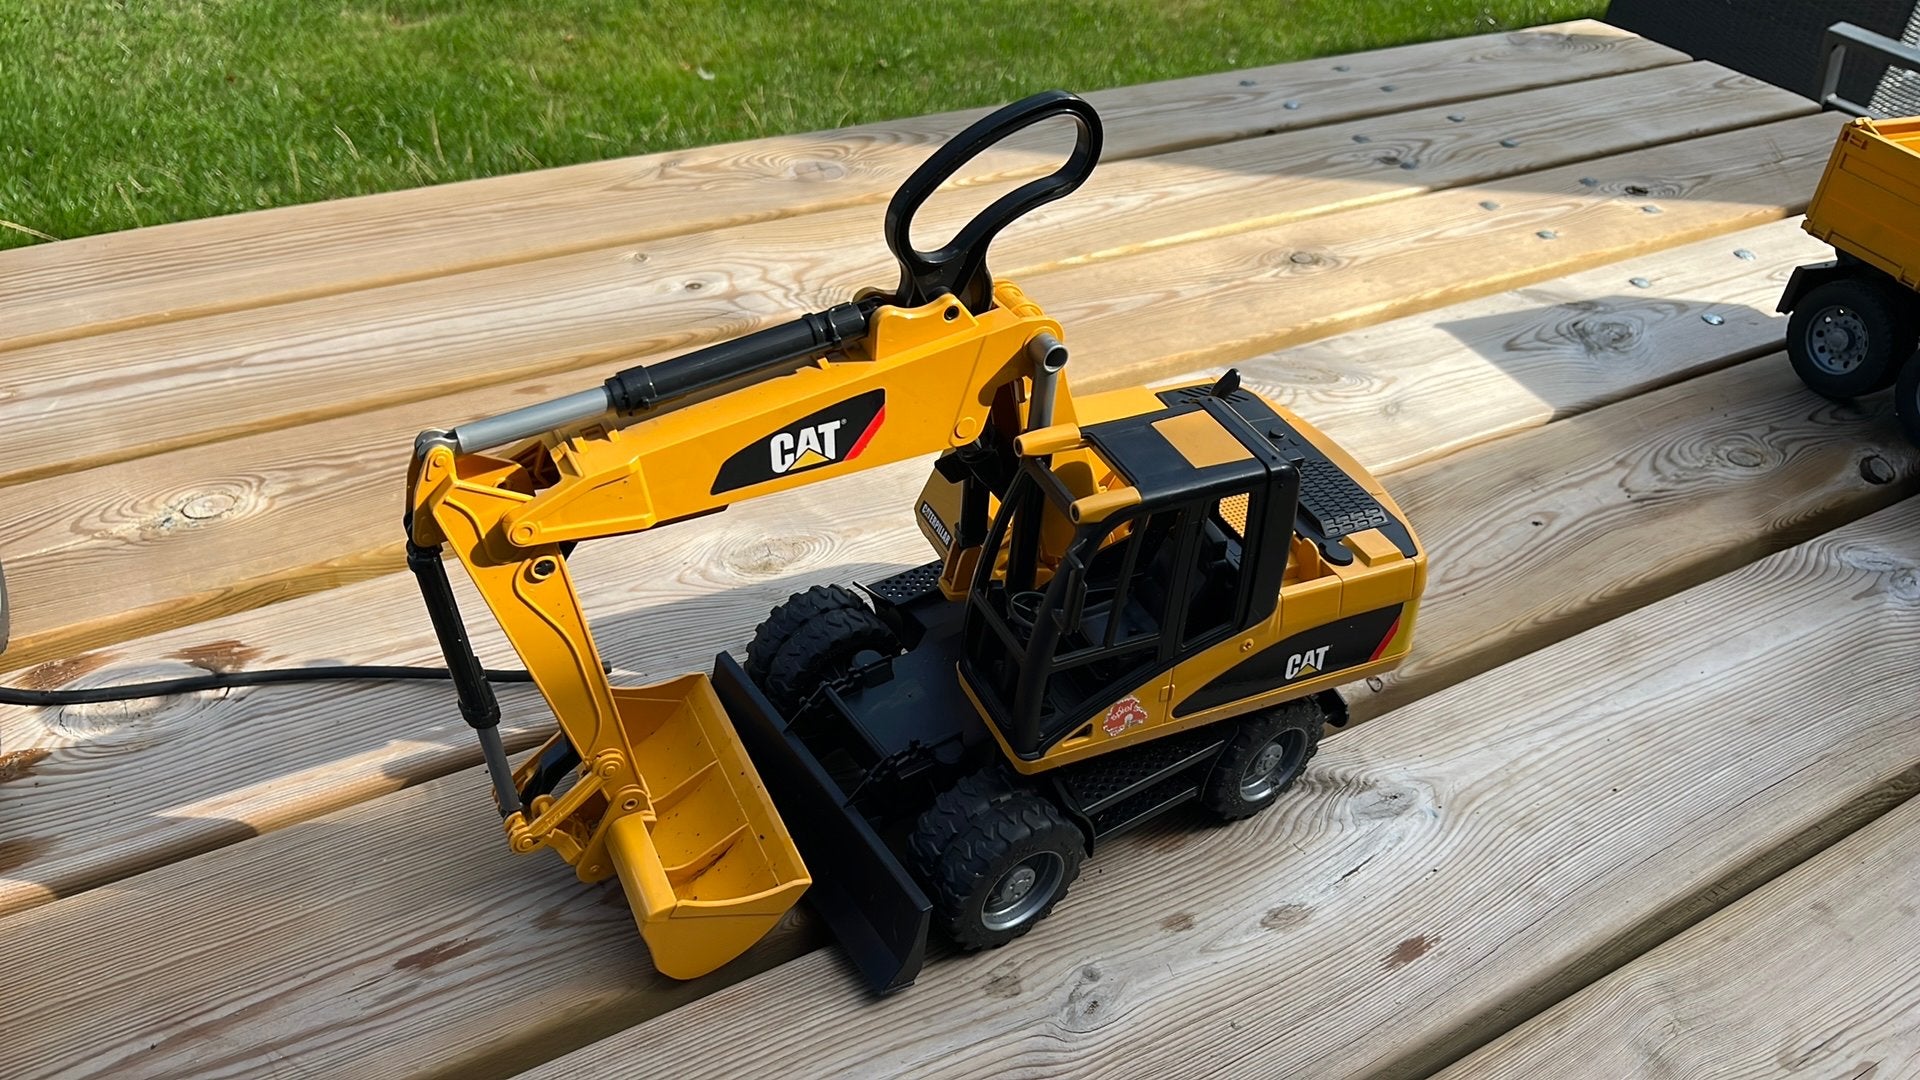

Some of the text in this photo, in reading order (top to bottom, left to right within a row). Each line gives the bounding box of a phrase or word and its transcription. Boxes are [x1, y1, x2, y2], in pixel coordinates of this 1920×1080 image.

[770, 420, 841, 474] CAT
[921, 503, 951, 546] CATERPILLAR
[1284, 645, 1330, 680] CAT
